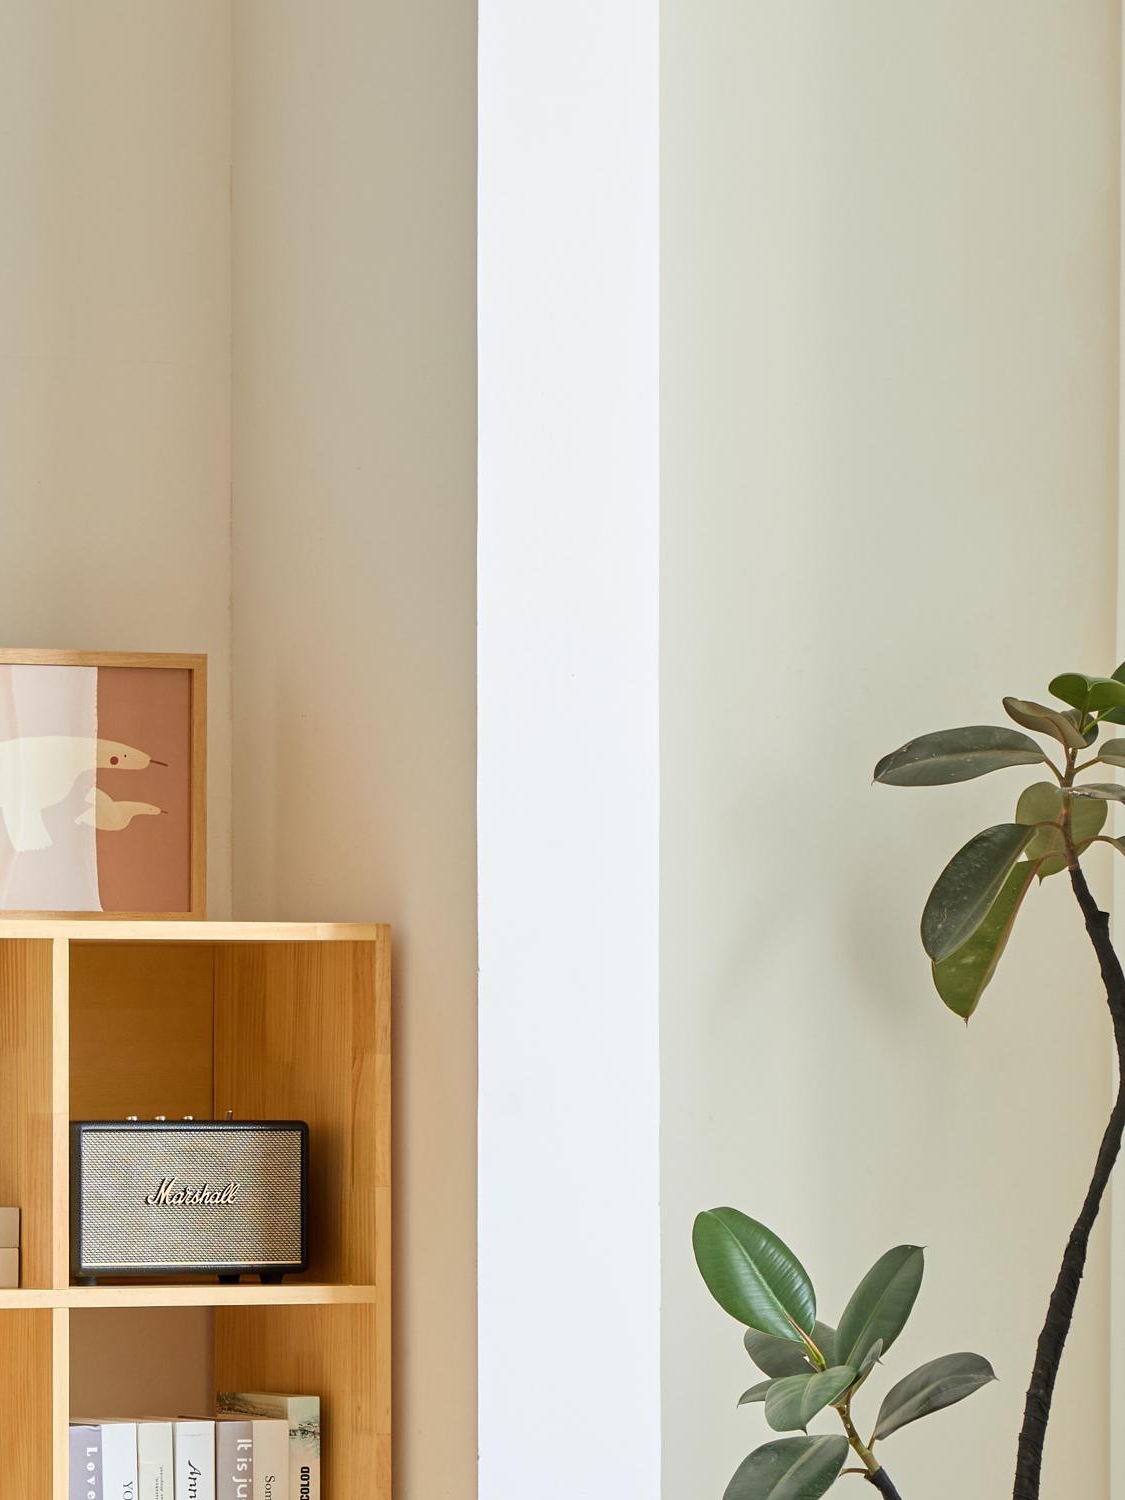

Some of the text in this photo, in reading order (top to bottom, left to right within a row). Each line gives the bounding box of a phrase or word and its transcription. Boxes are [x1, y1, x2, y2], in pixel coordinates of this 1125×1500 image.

[146, 1176, 240, 1206] Marshall
[237, 1439, 252, 1451] It
[86, 1447, 98, 1500] Love
[237, 1457, 251, 1472] is
